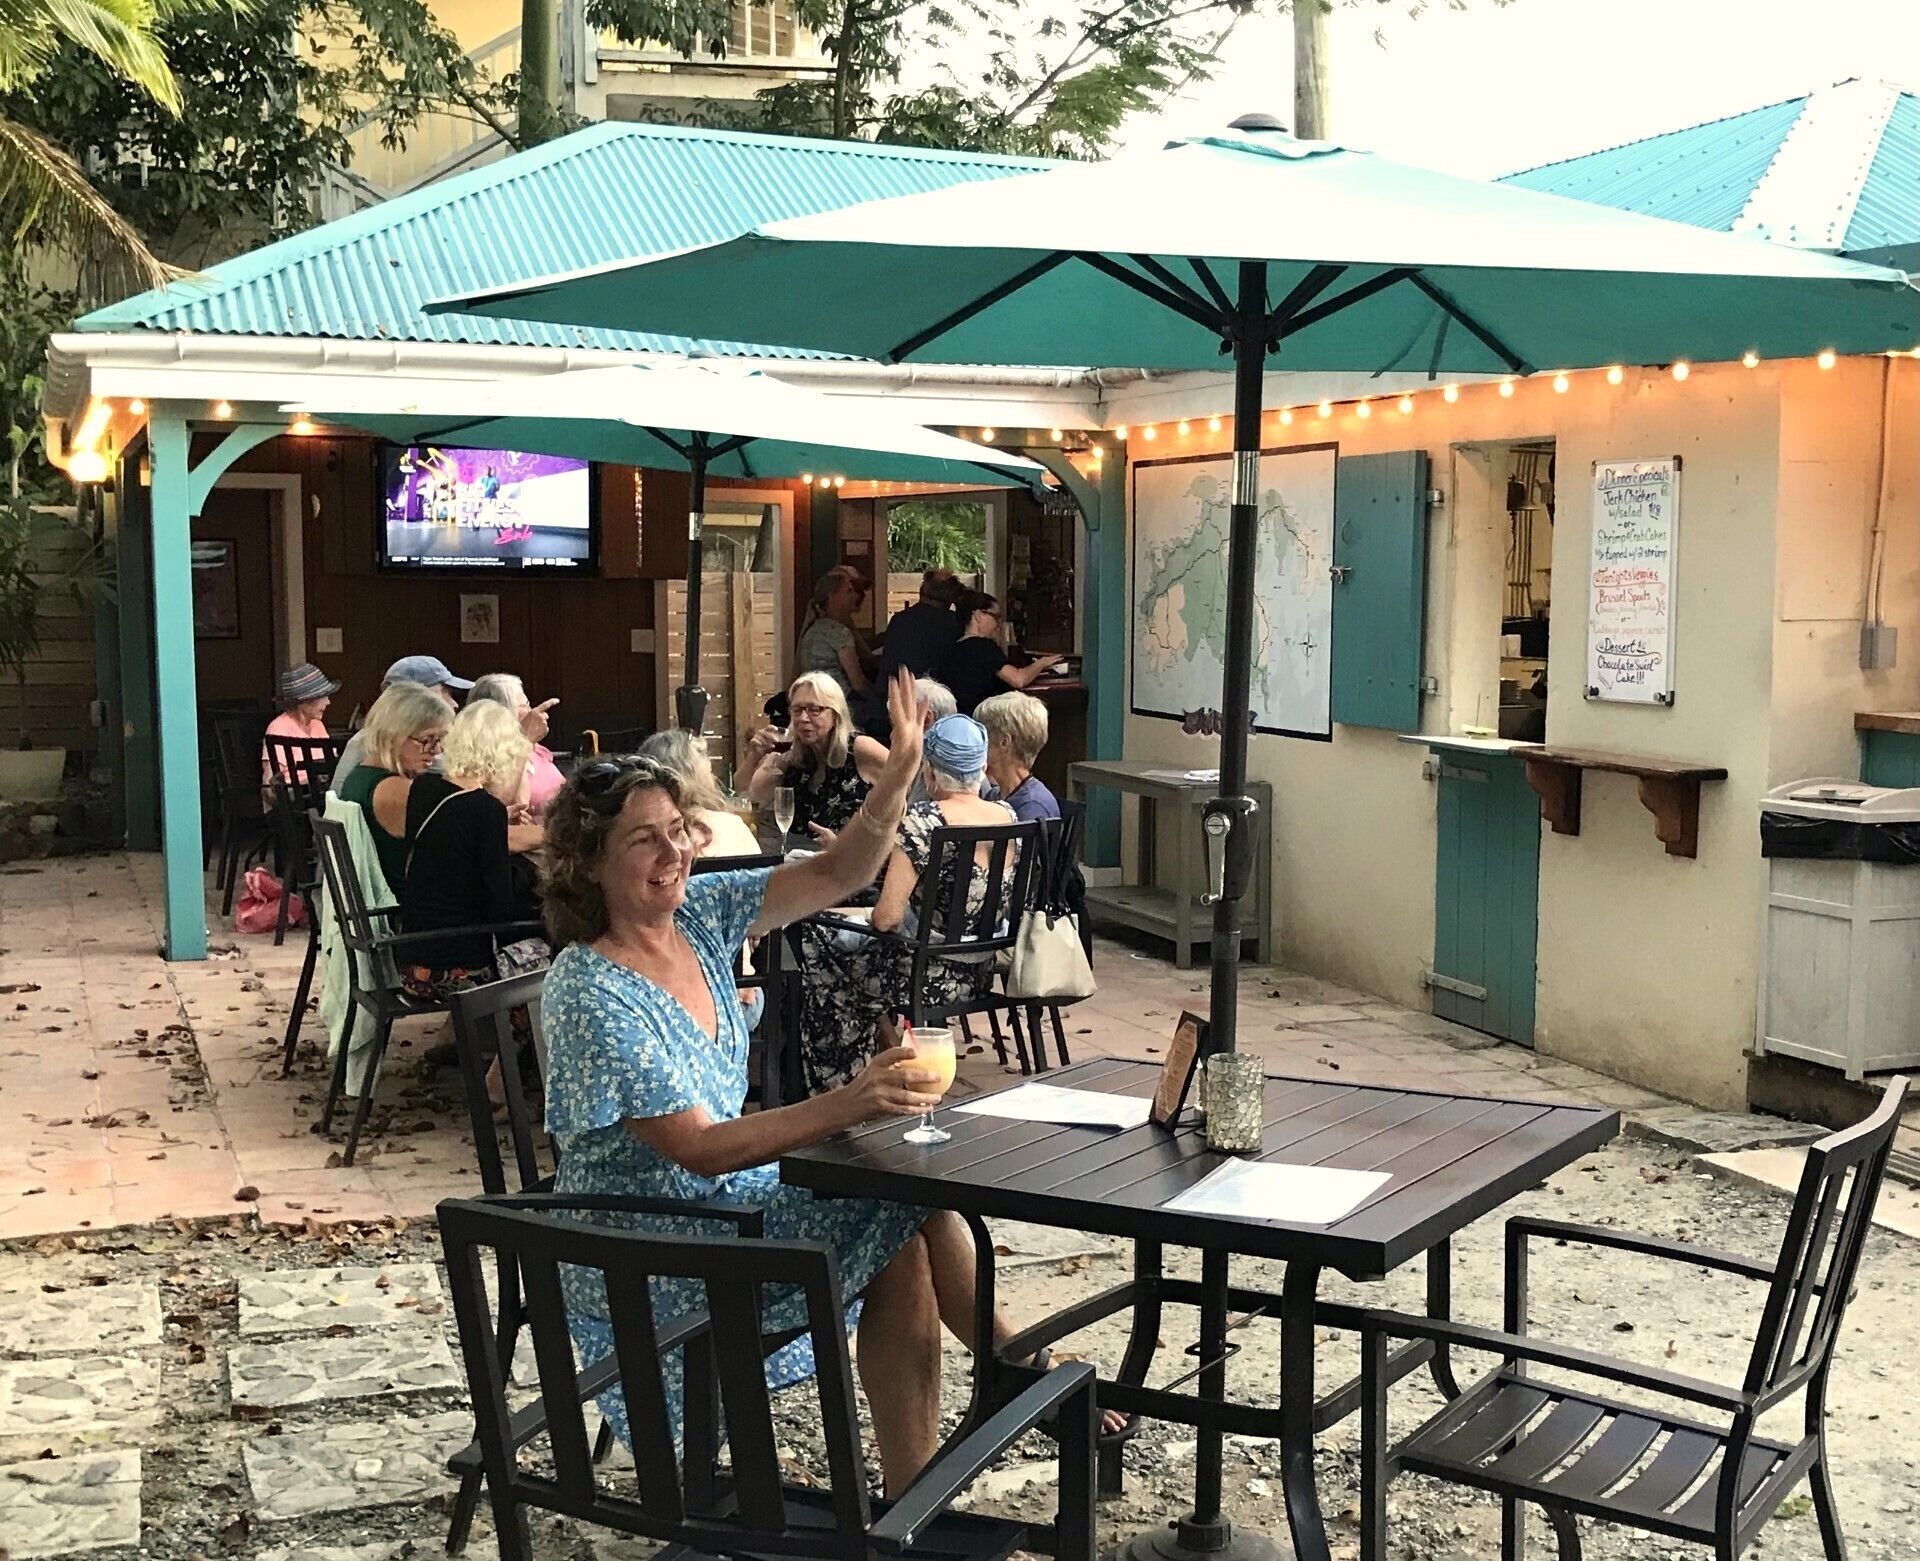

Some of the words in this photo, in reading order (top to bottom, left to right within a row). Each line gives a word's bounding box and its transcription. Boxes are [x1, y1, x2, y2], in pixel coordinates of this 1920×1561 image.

[1603, 490, 1623, 506] Jerk
[1624, 488, 1657, 505] Chicken
[1605, 637, 1636, 653] Dessert
[1597, 655, 1634, 673] Chocolate
